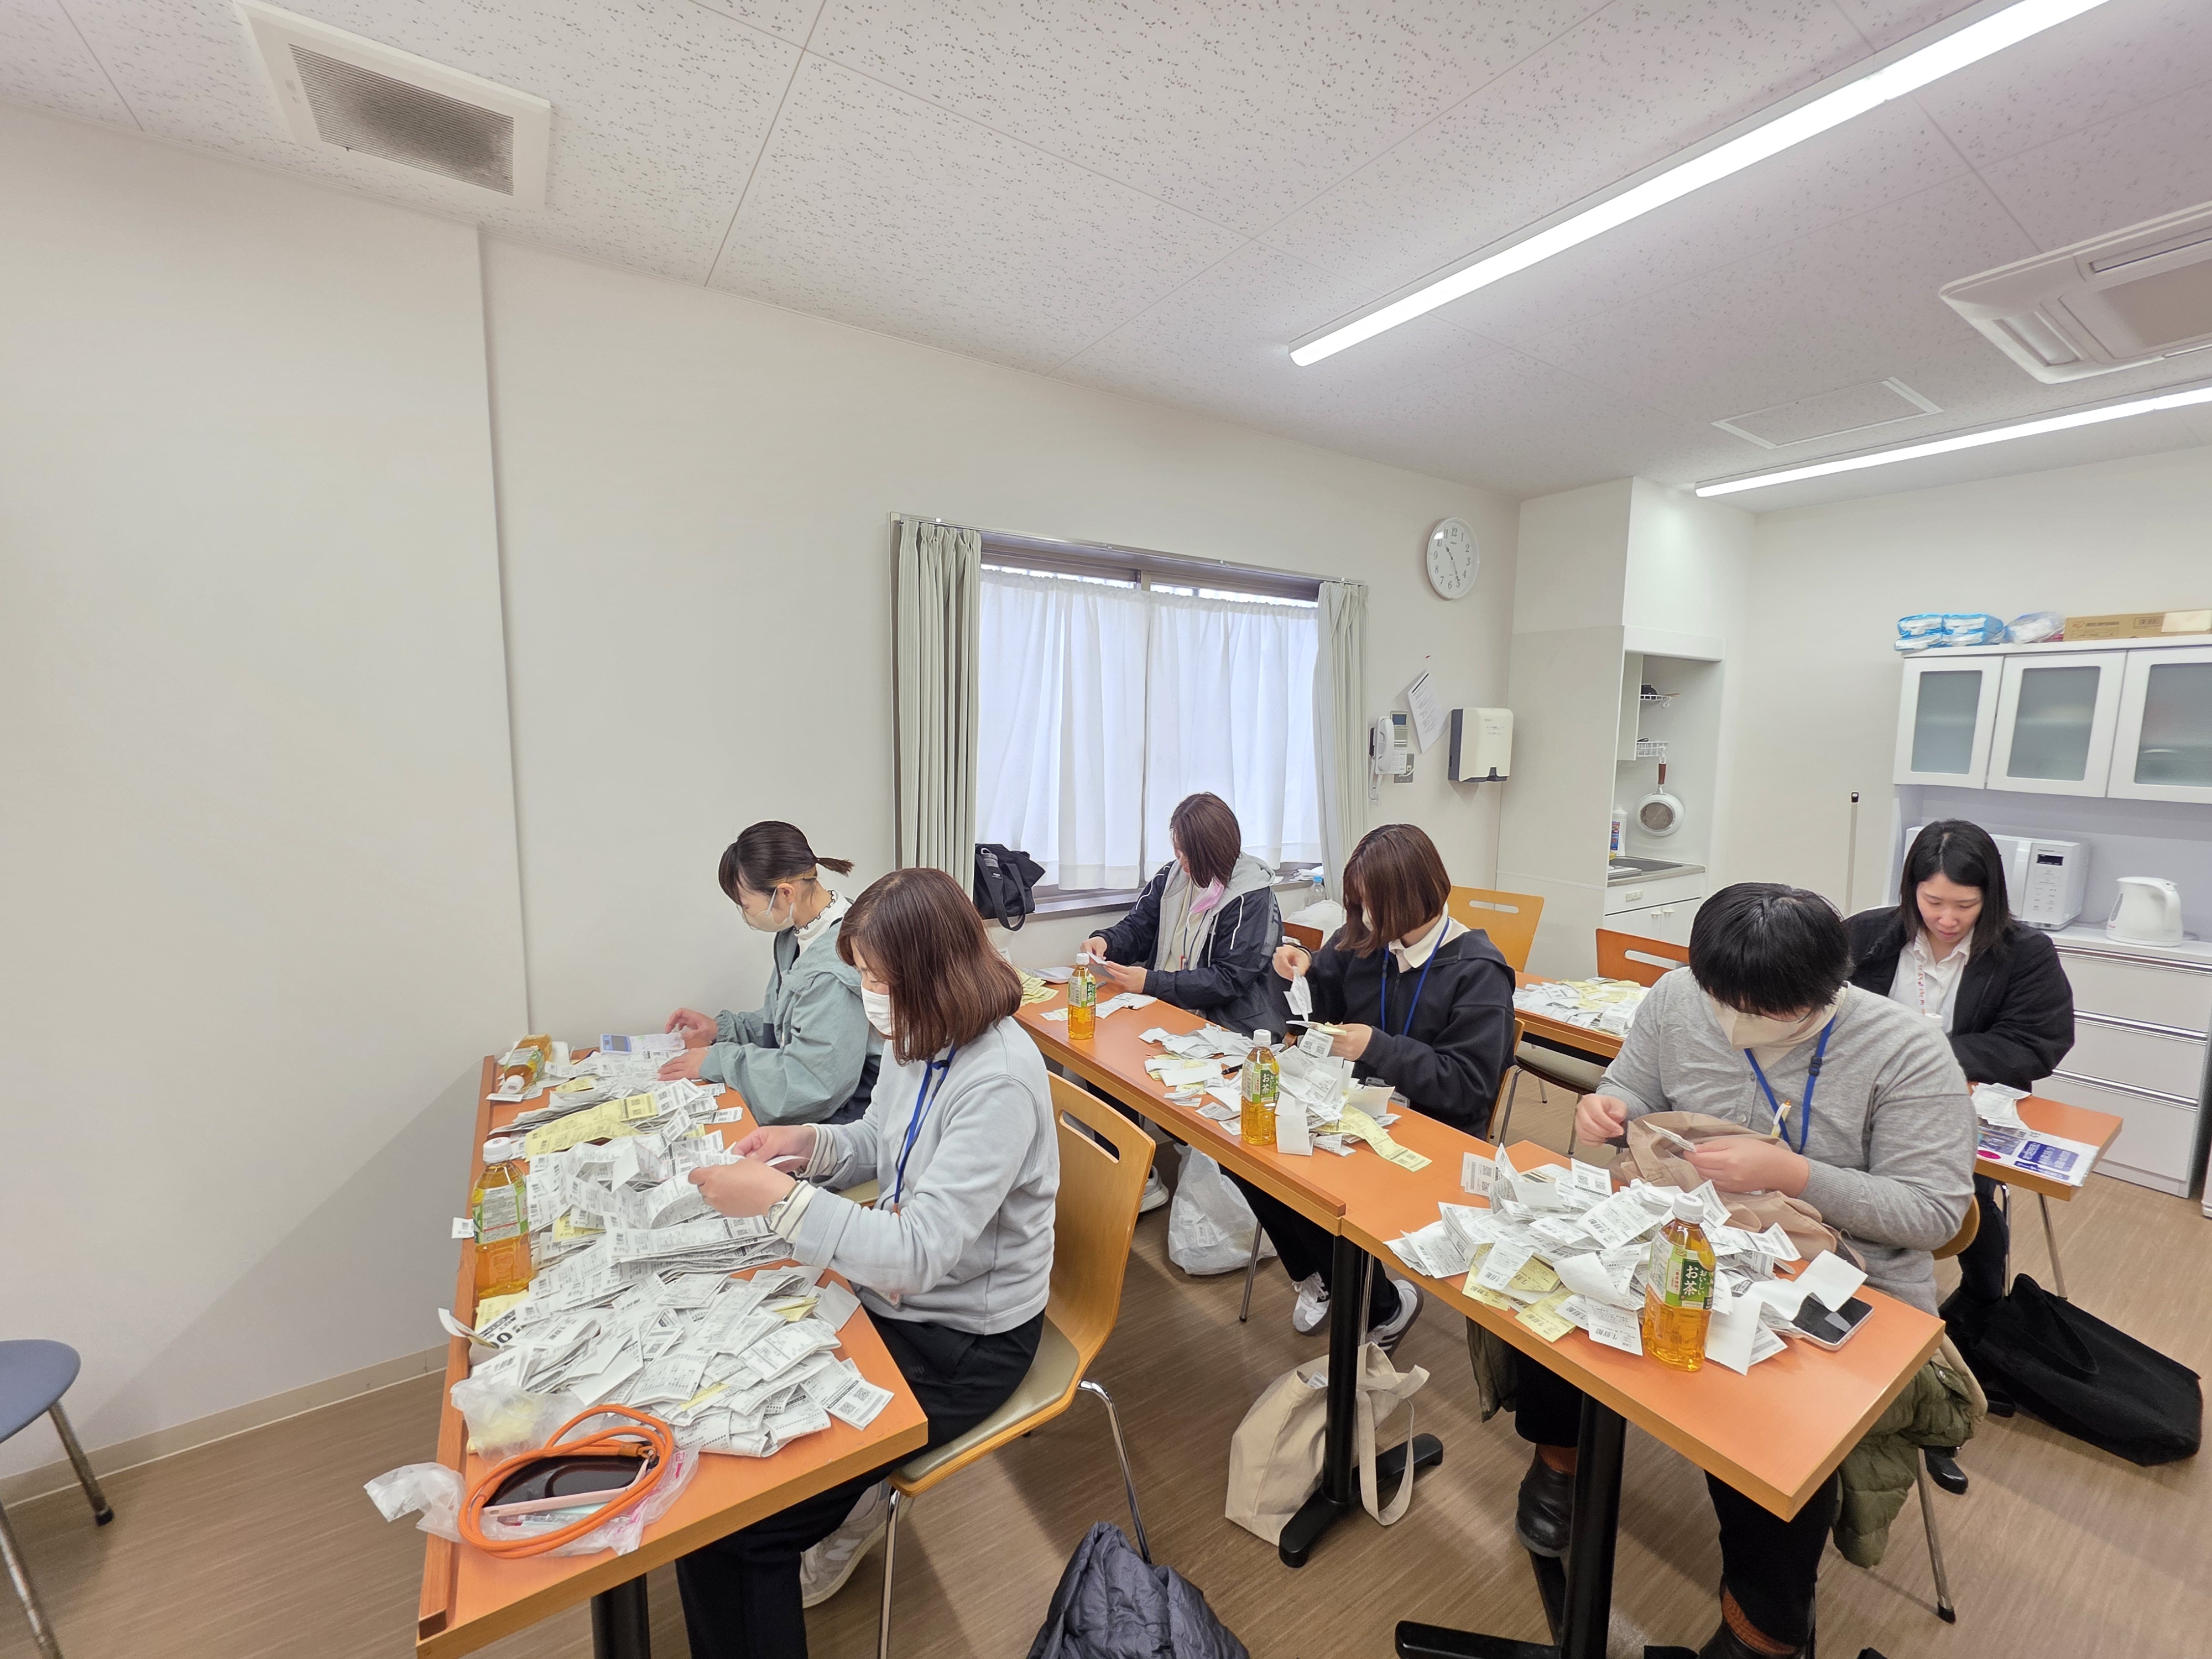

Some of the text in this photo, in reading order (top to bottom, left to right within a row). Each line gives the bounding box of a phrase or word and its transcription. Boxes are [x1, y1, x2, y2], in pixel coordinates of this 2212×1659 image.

[1444, 529, 1448, 539] 11
[1452, 527, 1458, 537] 12
[1465, 544, 1469, 552] 2
[1433, 551, 1438, 560] 9
[1466, 557, 1470, 566] 3
[1434, 565, 1438, 574] 8
[1462, 570, 1467, 578] 4
[1440, 576, 1444, 585] 7
[1448, 581, 1452, 589] 6
[1261, 1073, 1269, 1094] お茶
[1683, 1265, 1698, 1295] お茶
[1697, 1270, 1708, 1295] おいしい
[1595, 1327, 1618, 1340] 生鮮館
